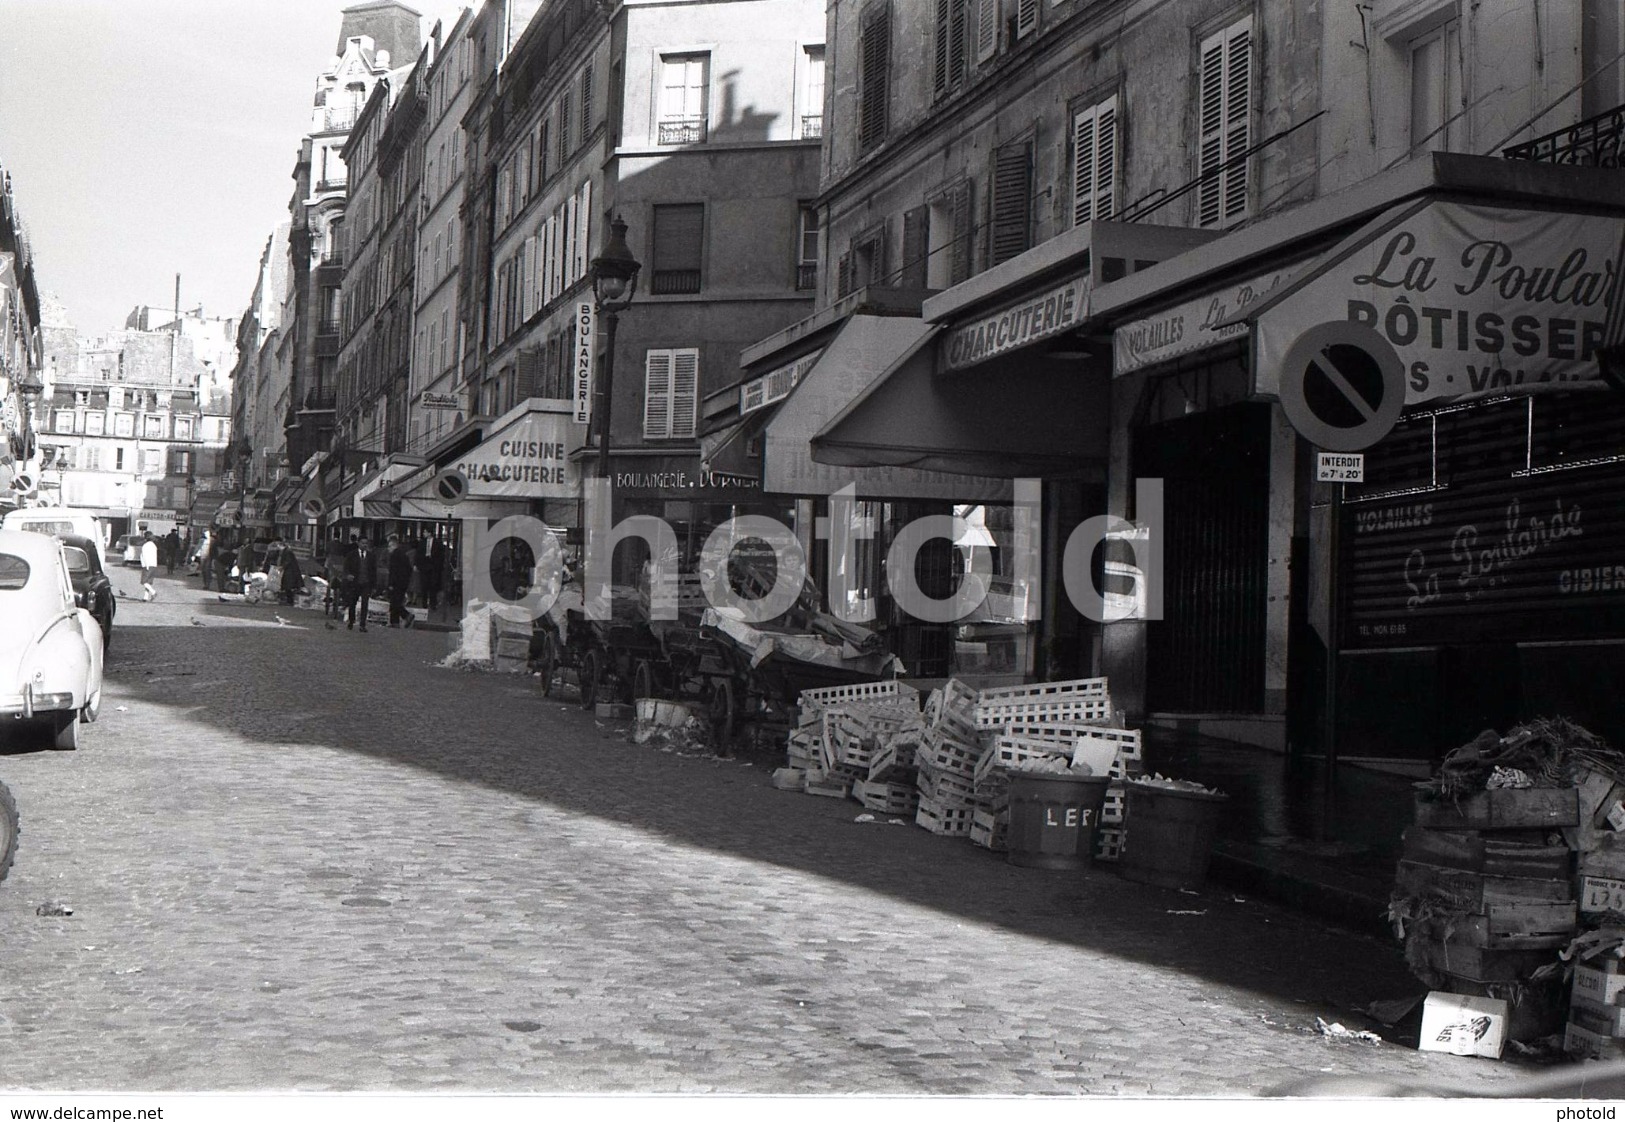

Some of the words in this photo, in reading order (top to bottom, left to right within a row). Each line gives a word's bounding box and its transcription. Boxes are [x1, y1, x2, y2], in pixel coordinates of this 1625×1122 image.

[1353, 231, 1437, 293] La
[950, 289, 1075, 364] CHARCUTERIE
[1129, 315, 1184, 354] VOLAILLES
[578, 305, 591, 422] BOULANGERIE
[500, 440, 564, 460] CUISINE
[1322, 456, 1360, 467] INTERDIT
[617, 470, 686, 488] BOULANGERIE
[1356, 503, 1433, 533] VOLAILLES
